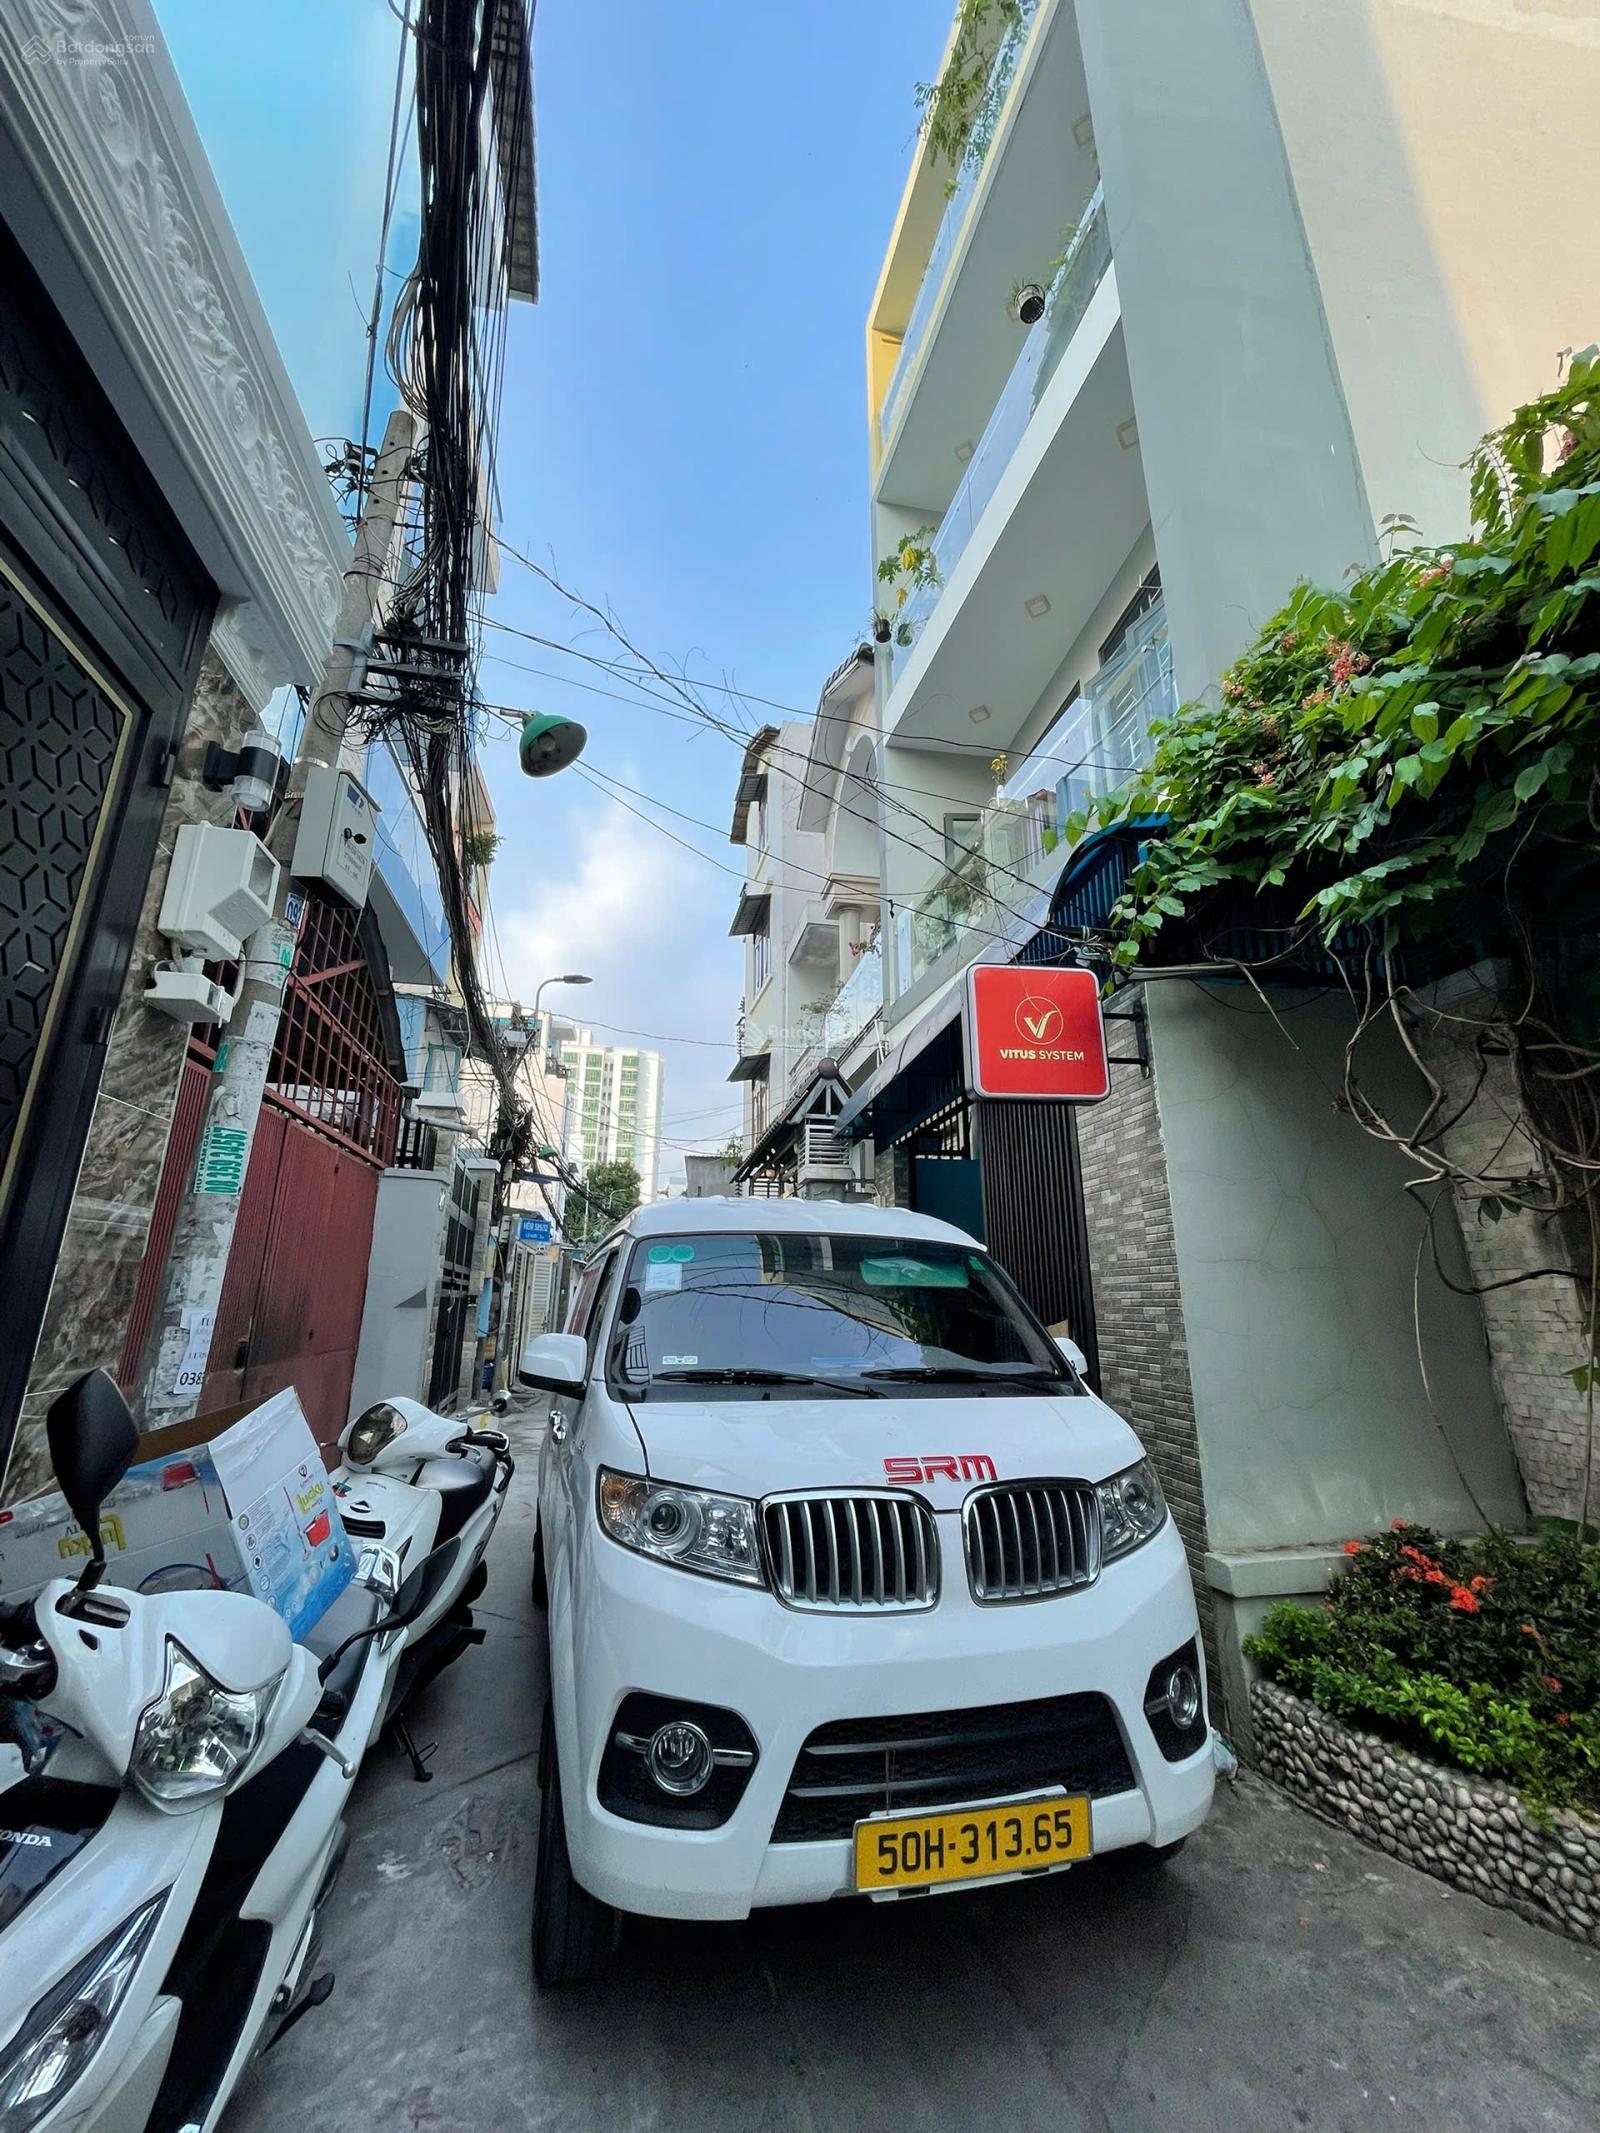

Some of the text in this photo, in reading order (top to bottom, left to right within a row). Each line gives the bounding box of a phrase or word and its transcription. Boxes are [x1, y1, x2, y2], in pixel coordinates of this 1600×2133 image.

[1000, 1049, 1085, 1061] VITUS SYSTEM
[883, 1455, 998, 1484] SRM
[0, 1829, 52, 1847] ONDA
[877, 1809, 1072, 1876] 50H-313.65
